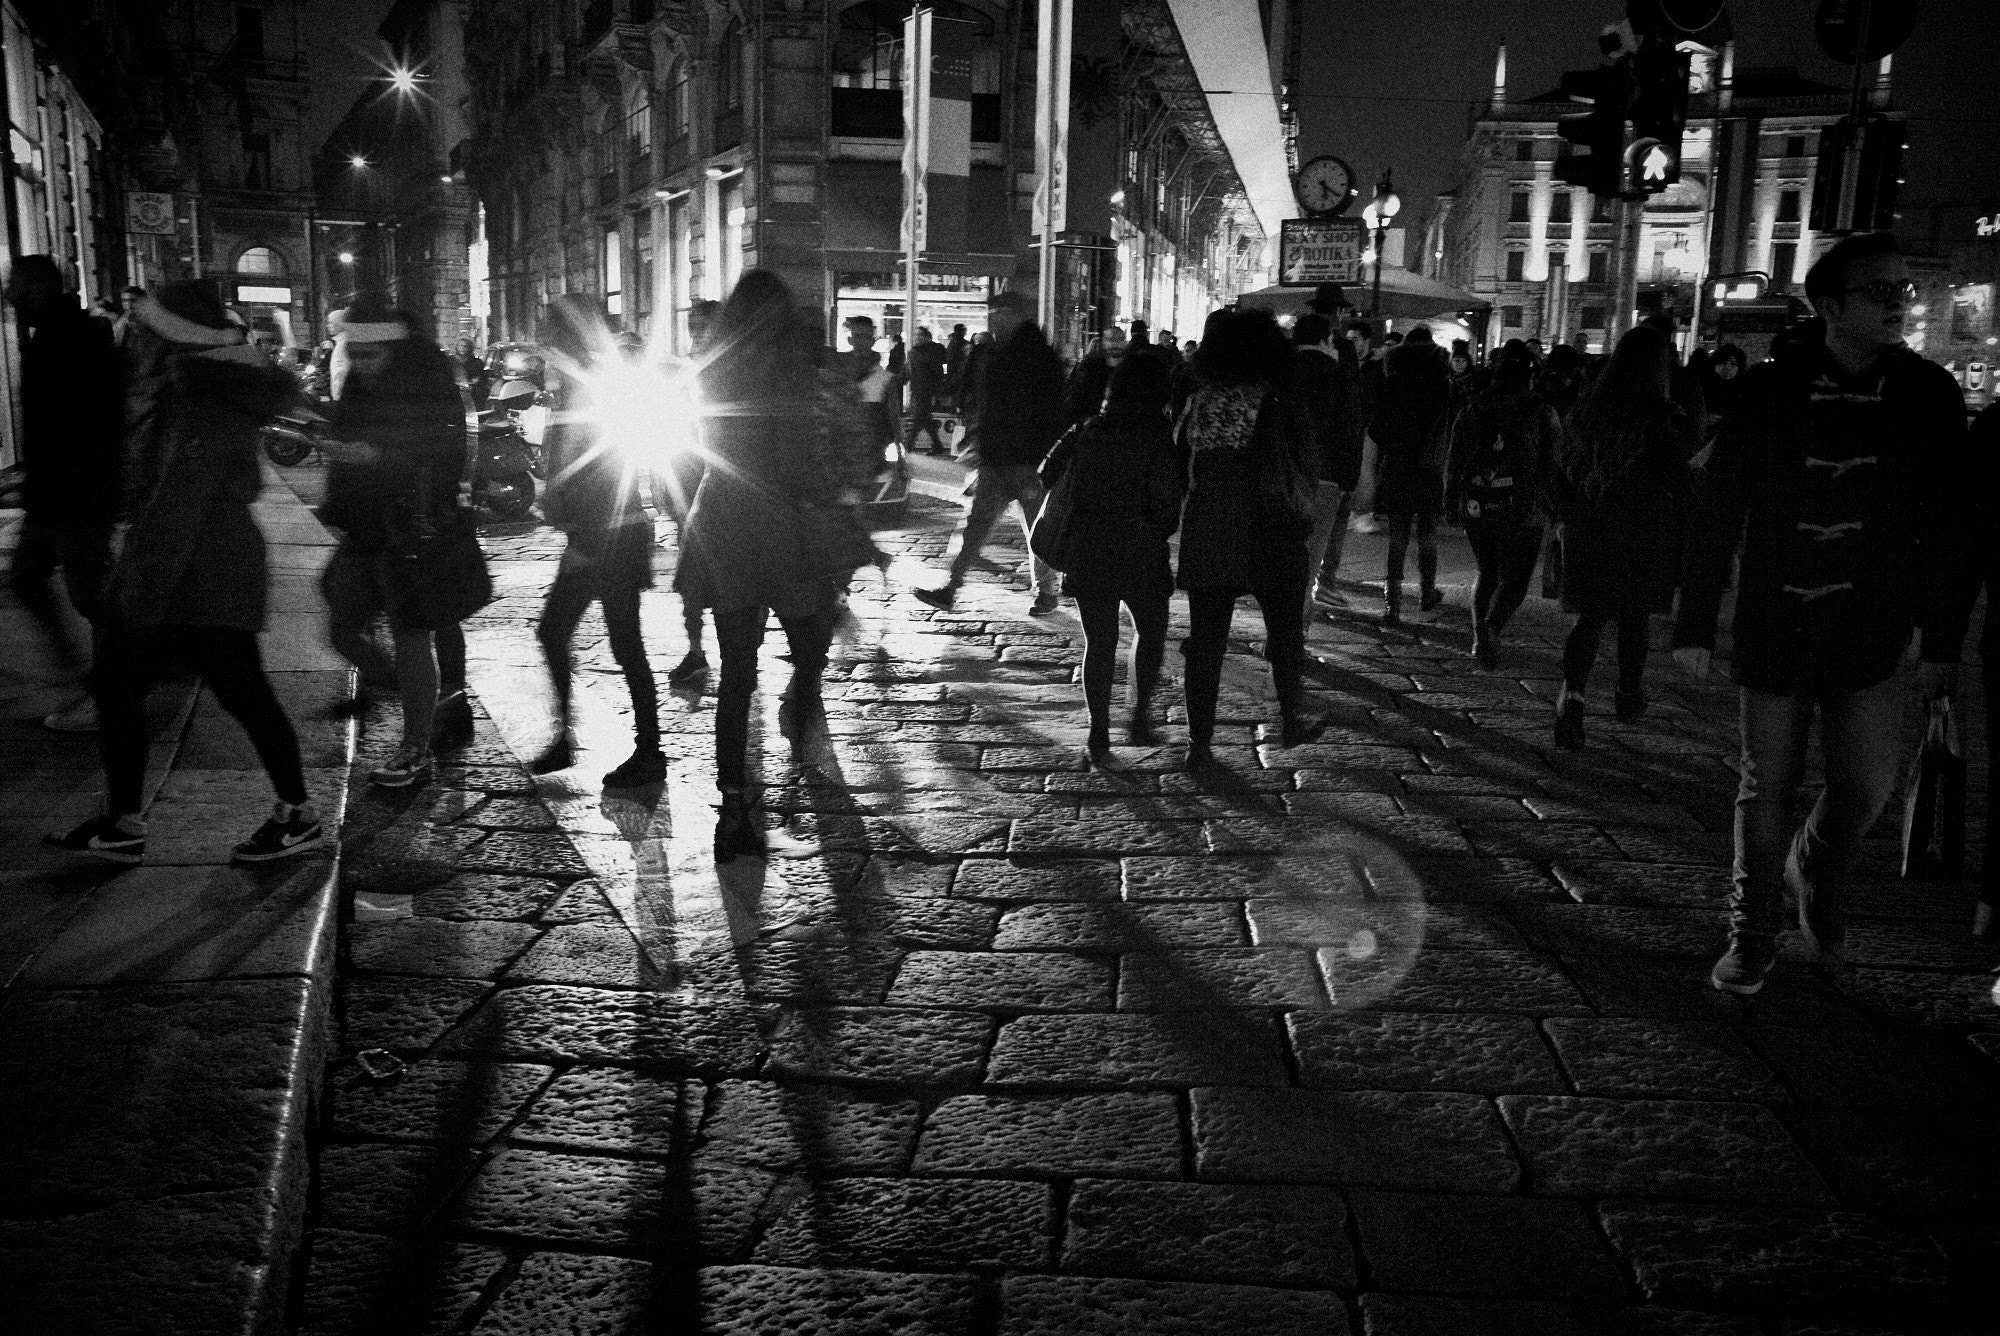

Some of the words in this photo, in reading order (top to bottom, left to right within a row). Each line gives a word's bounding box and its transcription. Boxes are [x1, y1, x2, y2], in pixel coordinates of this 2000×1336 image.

[1285, 232, 1319, 244] SEXY
[1322, 232, 1359, 243] SHOP
[1289, 245, 1352, 261] EROTIKA
